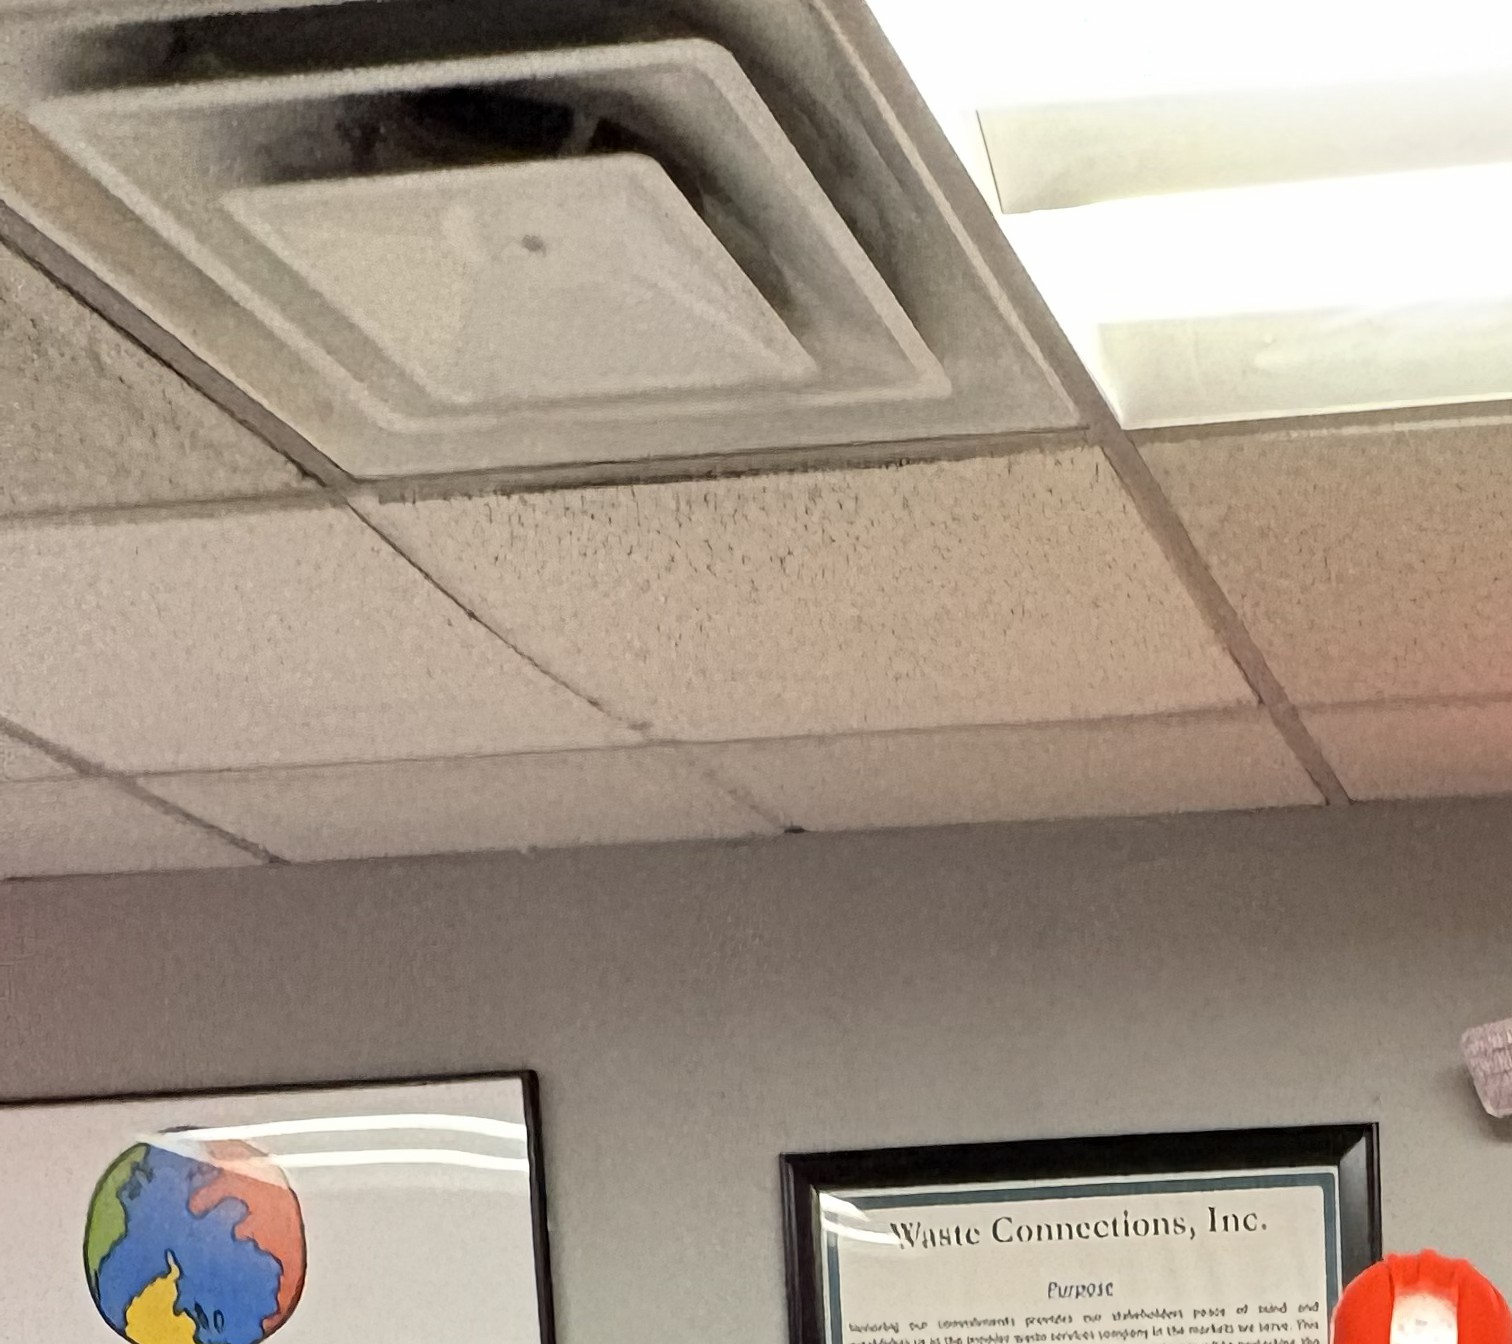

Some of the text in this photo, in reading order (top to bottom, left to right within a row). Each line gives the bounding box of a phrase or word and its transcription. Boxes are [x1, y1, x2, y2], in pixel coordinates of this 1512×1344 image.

[889, 1206, 1269, 1249] Waste Connections, Inc.
[1047, 1281, 1114, 1299] Purpose
